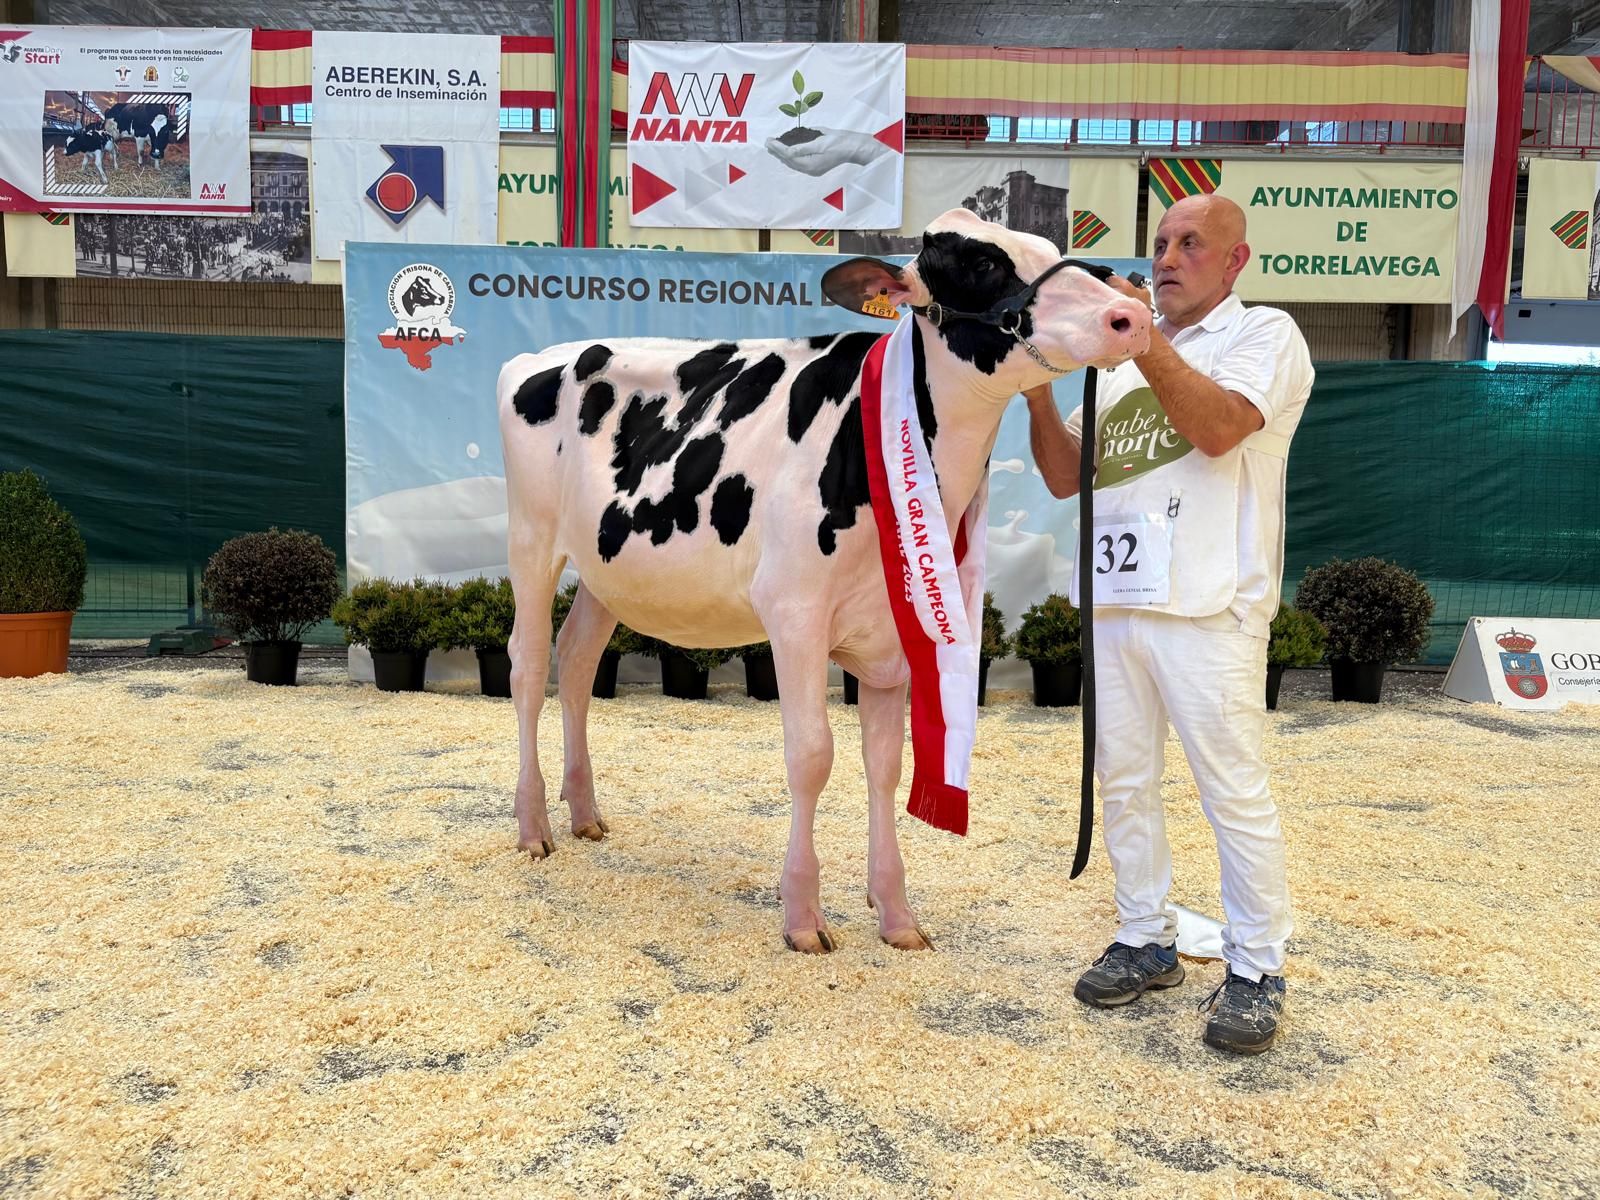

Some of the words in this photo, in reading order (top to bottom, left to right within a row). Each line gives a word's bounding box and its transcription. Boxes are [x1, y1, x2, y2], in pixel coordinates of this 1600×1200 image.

[25, 53, 61, 65] Start
[325, 65, 441, 90] ABEREKIN,
[447, 69, 487, 87] S.A.
[325, 85, 372, 98] Centro
[375, 87, 393, 98] de
[396, 87, 487, 101] Inseminación
[630, 118, 748, 143] NANTA
[1249, 186, 1458, 210] AYUNTAMIENTO
[1336, 221, 1368, 243] DE
[1258, 254, 1441, 277] TORRELAVEGA
[402, 265, 433, 276] FRISONA
[442, 277, 454, 315] CANTABRIA
[468, 273, 651, 302] CONCURSO
[659, 279, 813, 306] REGIONAL
[394, 326, 442, 342] AFCA
[1103, 408, 1157, 439] sabe
[900, 418, 918, 493] NOVILLA
[1102, 427, 1181, 461] norte
[907, 497, 929, 548] GRAN
[1096, 532, 1139, 575] 32
[918, 552, 956, 645] CAMPEONA
